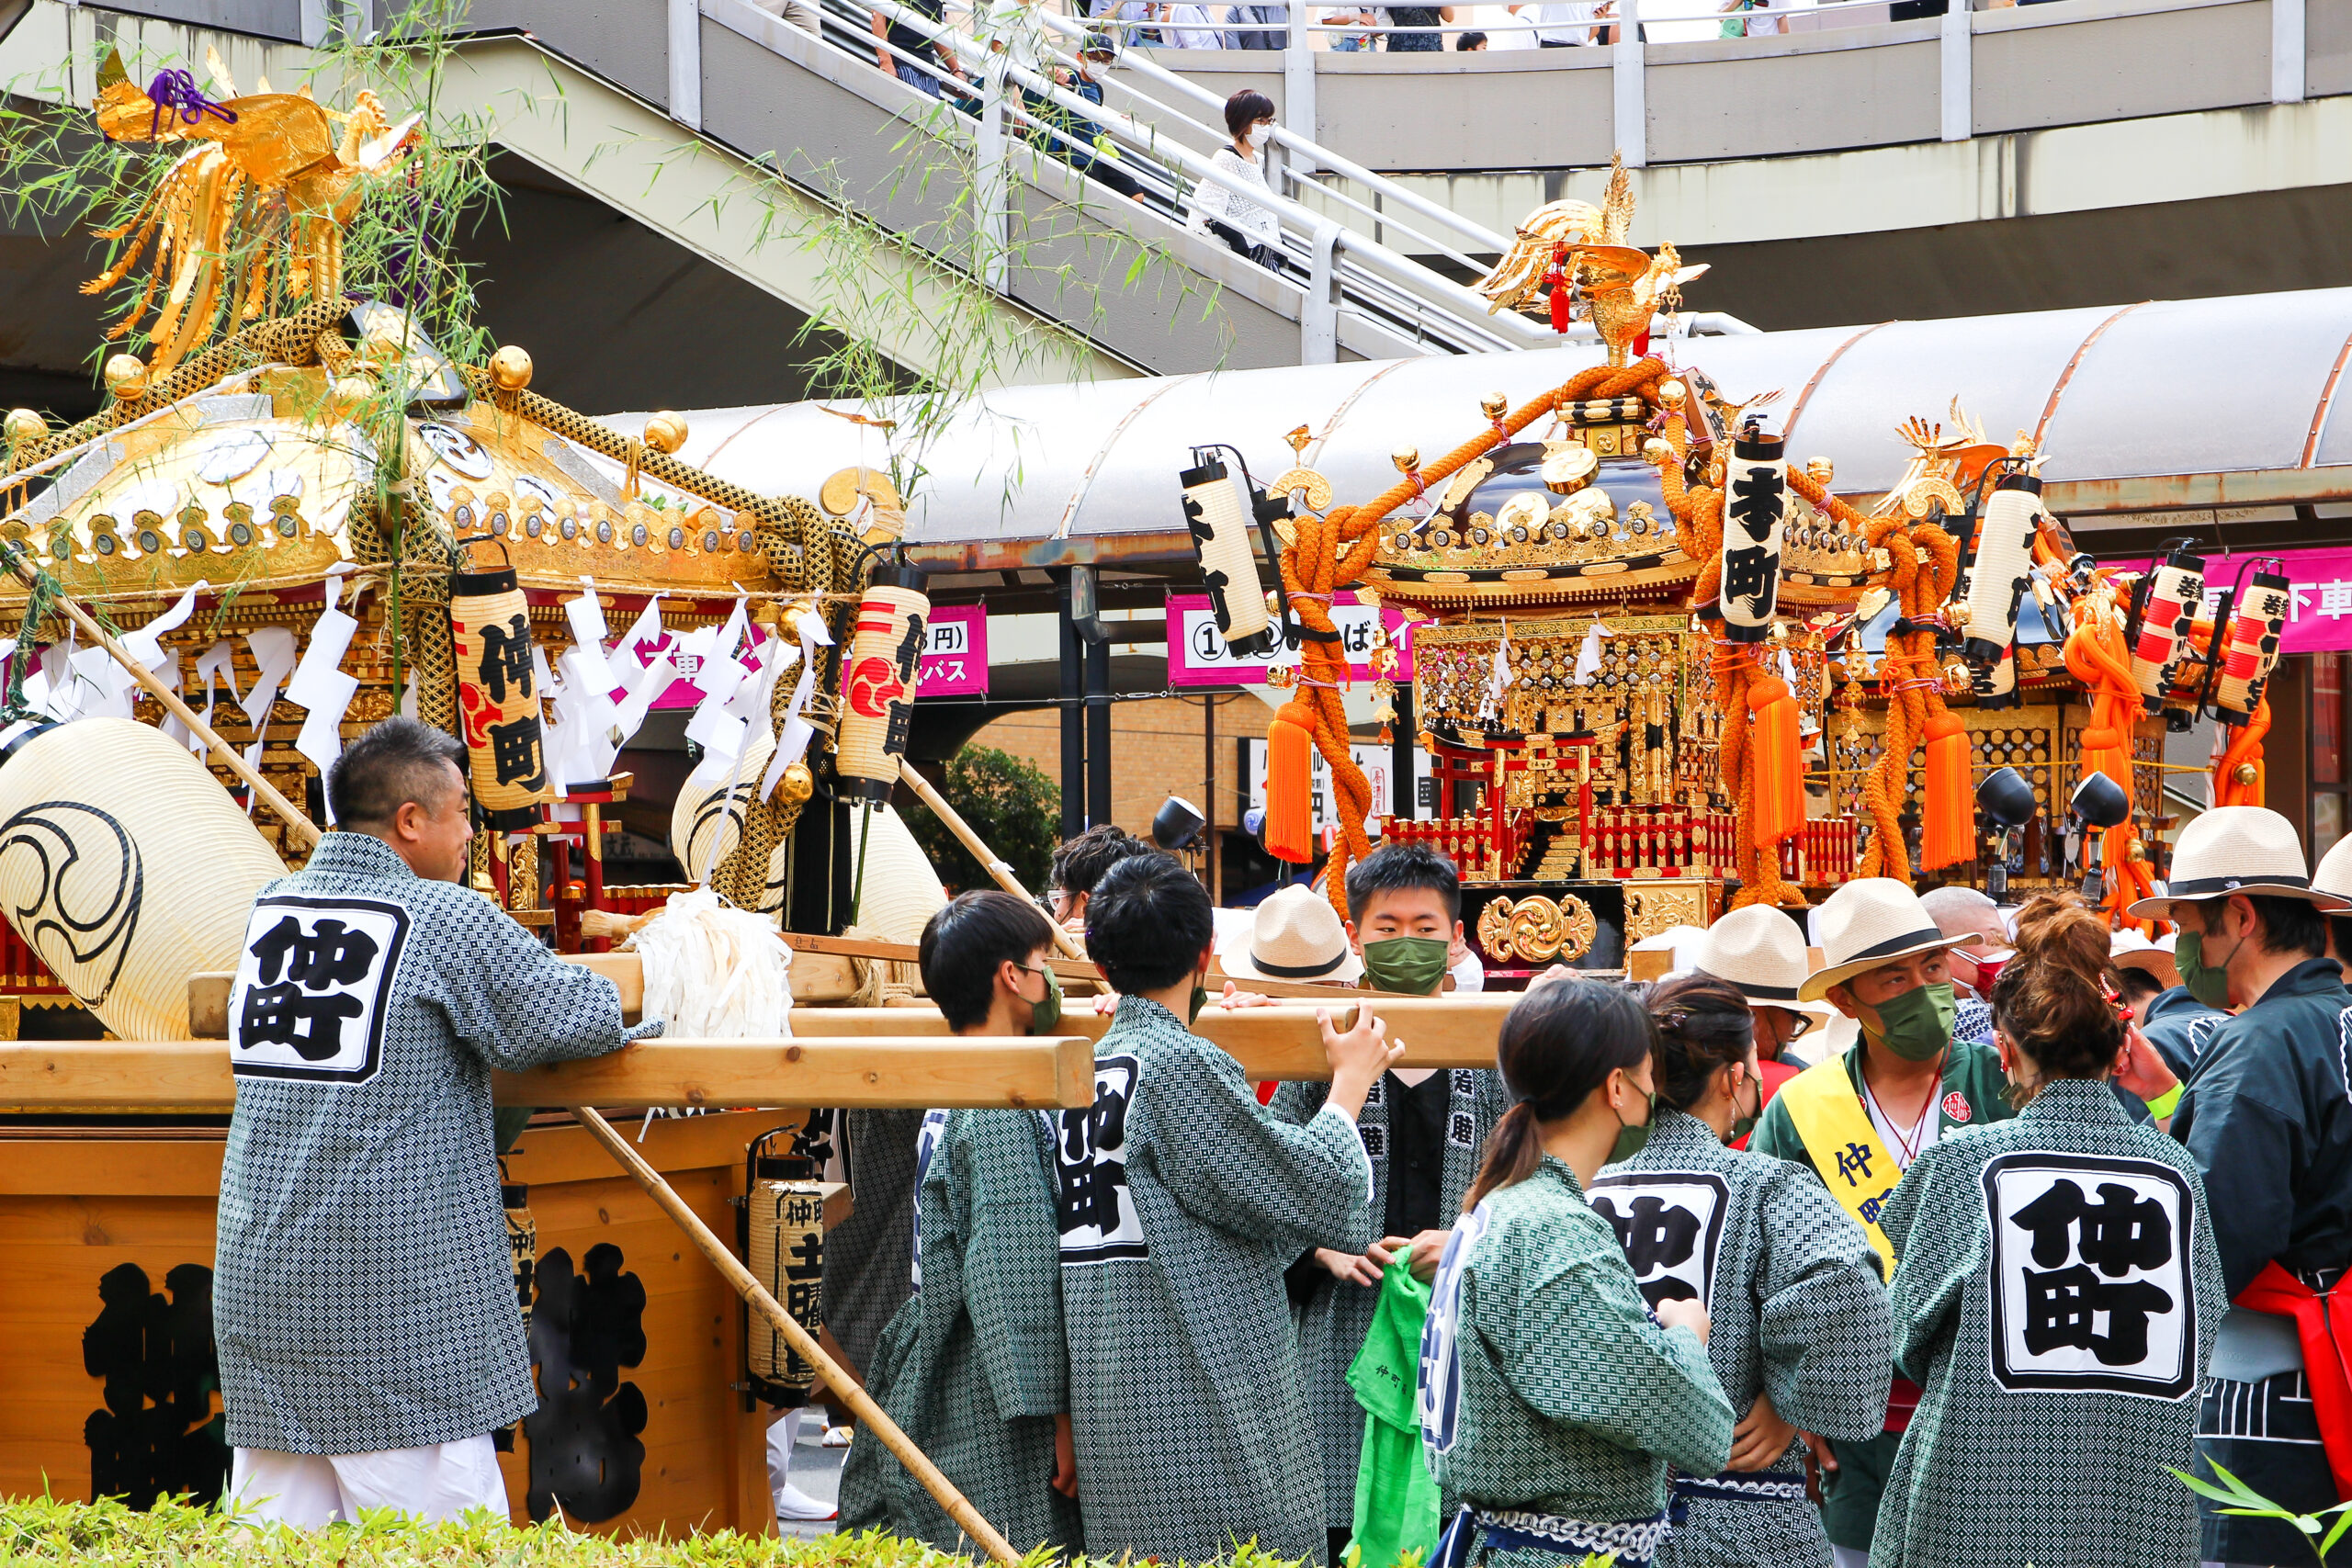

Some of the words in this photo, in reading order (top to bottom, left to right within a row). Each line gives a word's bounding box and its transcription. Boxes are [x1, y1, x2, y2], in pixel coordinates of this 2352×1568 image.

[1726, 467, 1784, 619] 本町
[478, 614, 546, 793] 仲町
[922, 626, 963, 649] 円)
[239, 915, 379, 1062] 仲町
[2009, 1179, 2174, 1366] 仲町
